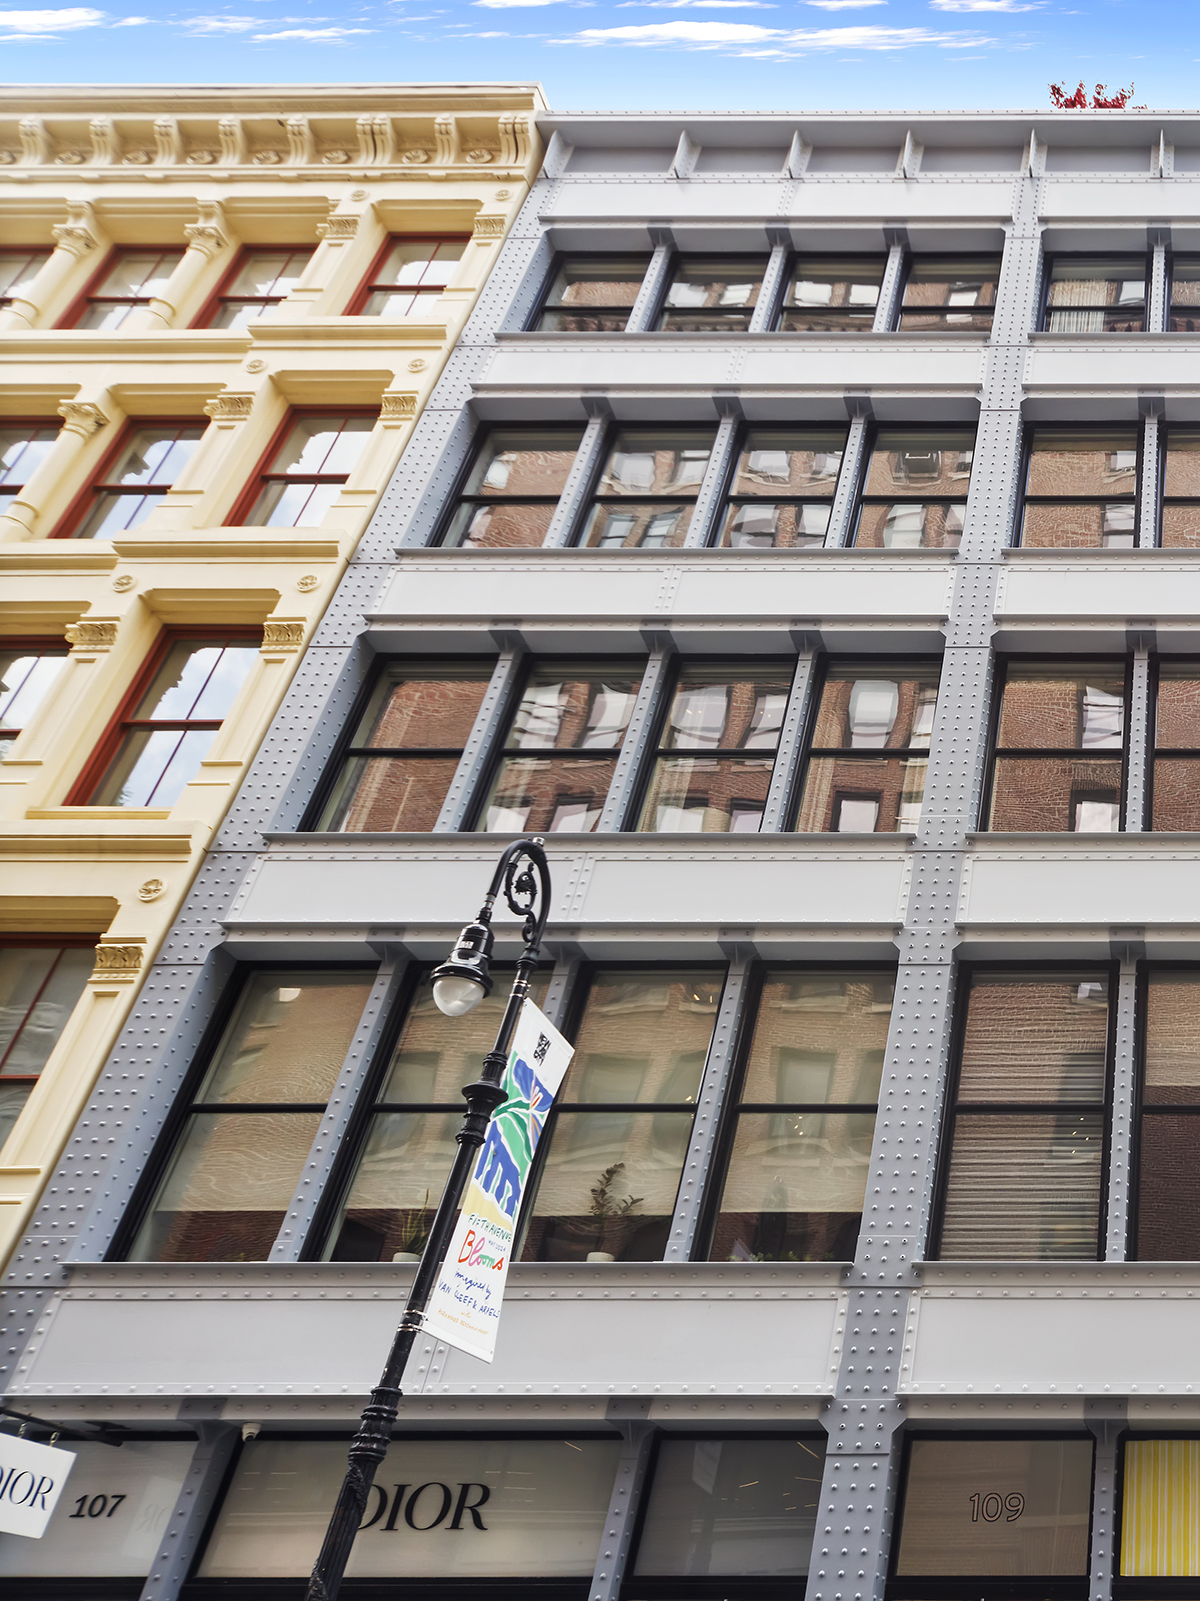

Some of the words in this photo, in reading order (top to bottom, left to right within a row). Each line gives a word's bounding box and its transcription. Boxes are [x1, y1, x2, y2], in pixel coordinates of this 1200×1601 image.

[458, 1229, 504, 1271] Blooms
[438, 1279, 452, 1294] VAN
[0, 1465, 54, 1511] IOR
[69, 1494, 126, 1518] 107
[970, 1492, 1025, 1522] 109
